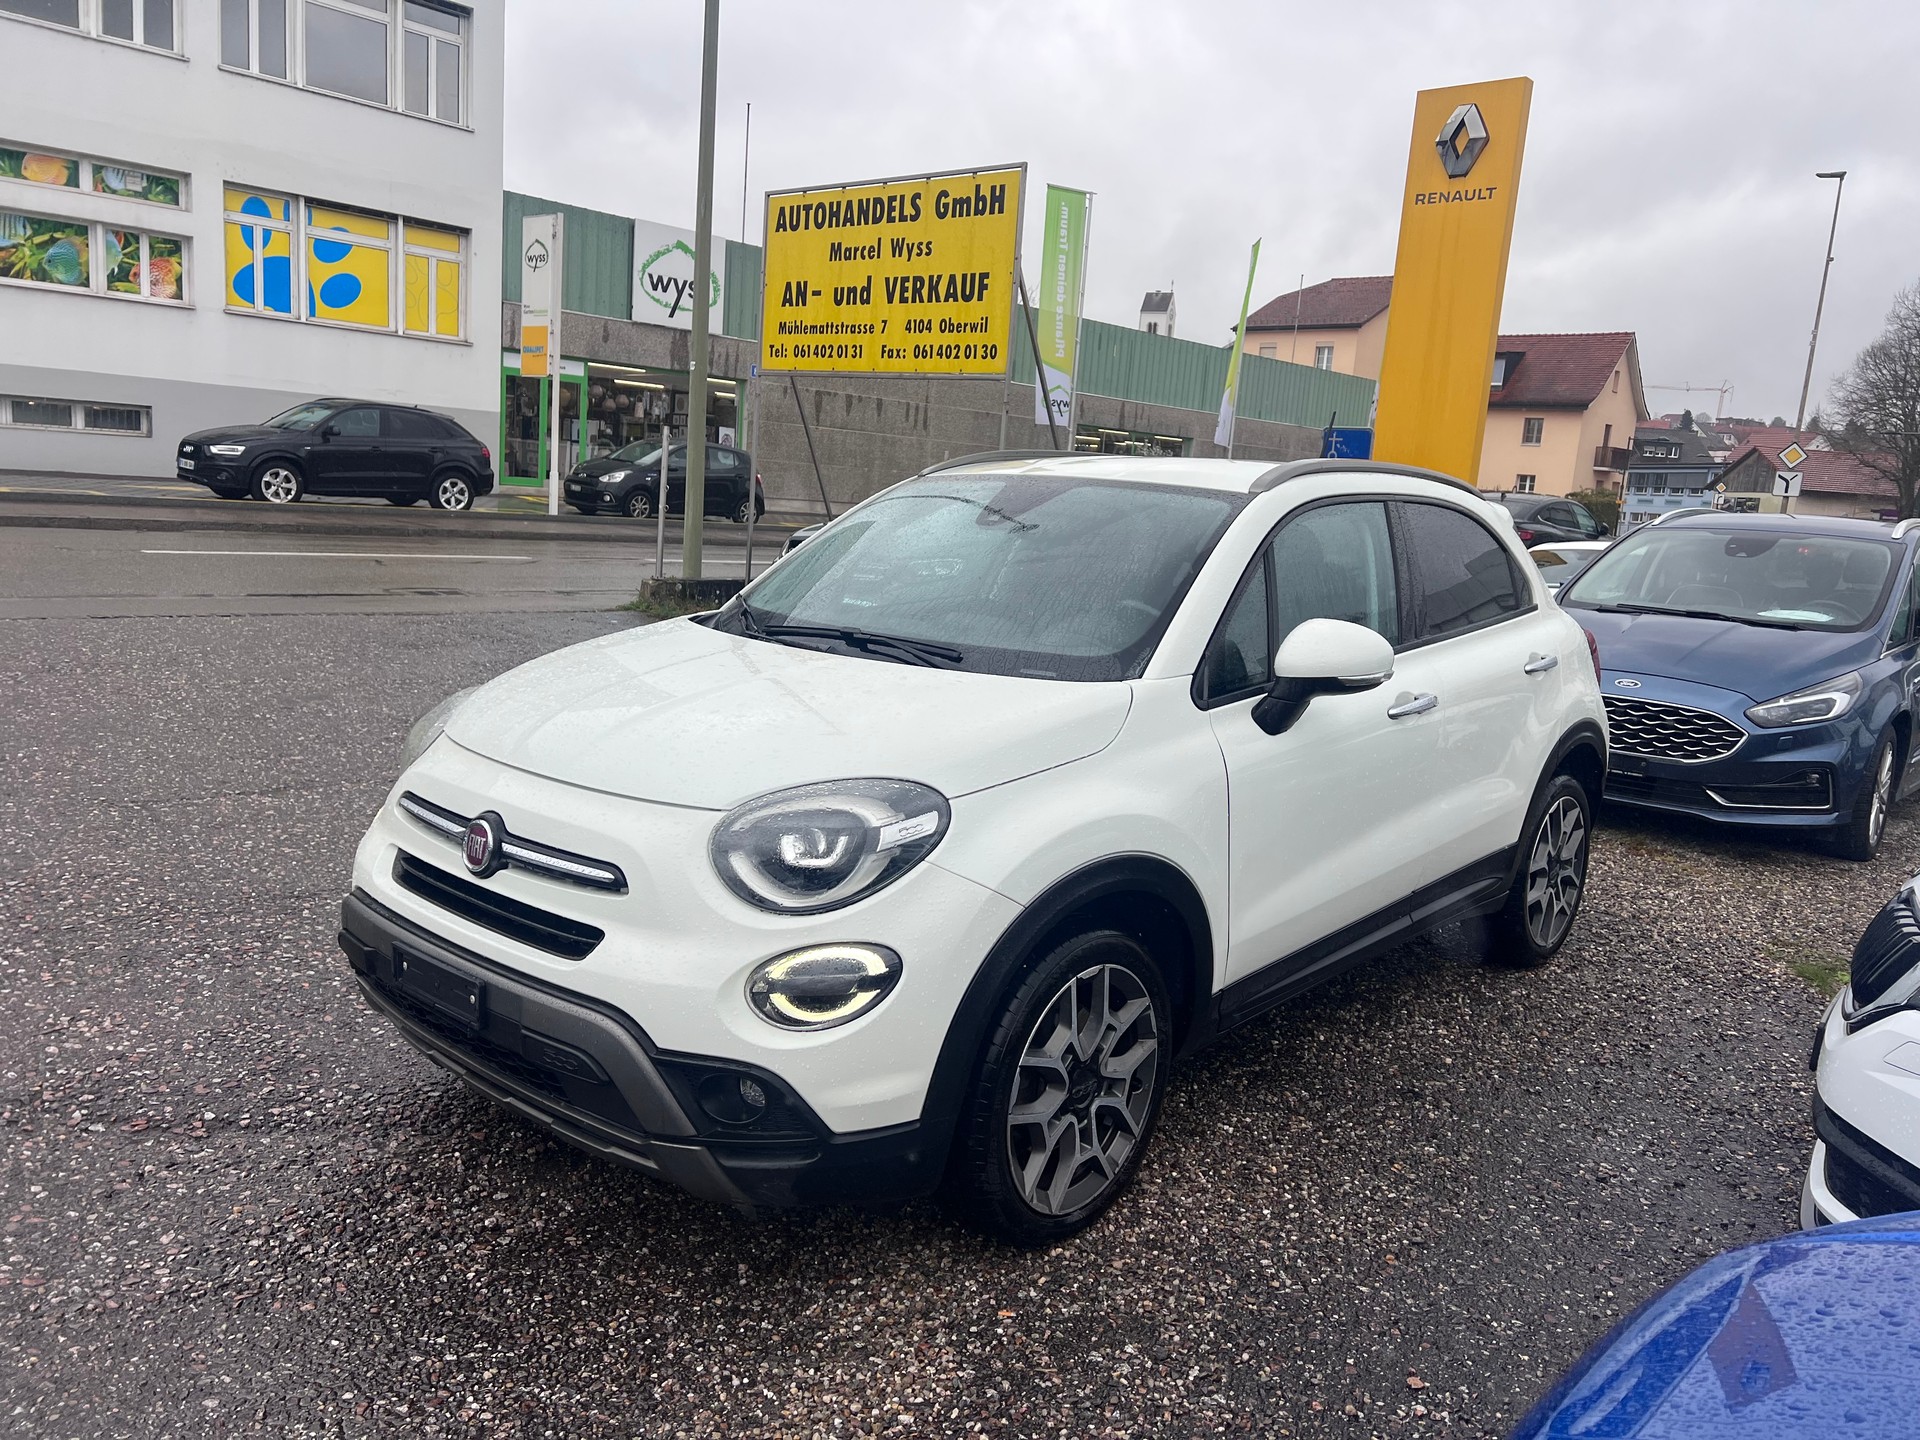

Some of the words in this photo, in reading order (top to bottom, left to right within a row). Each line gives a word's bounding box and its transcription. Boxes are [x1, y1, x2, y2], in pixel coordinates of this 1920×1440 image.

[1414, 187, 1498, 206] RENAULT
[774, 192, 923, 233] AUTOHANDELS
[934, 183, 1006, 221] GmbH
[828, 236, 882, 262] Marcel
[890, 238, 933, 262] Wyss
[527, 253, 546, 272] wyss
[833, 275, 872, 307] und
[884, 271, 990, 305] VERKAUF
[778, 319, 875, 335] Mühlemattstrasse
[880, 319, 888, 334] 7
[904, 318, 933, 334] 4104
[939, 316, 989, 334] Oberwil
[769, 343, 788, 358] Tel:
[880, 344, 907, 360] Fax:
[467, 833, 487, 860] FIAT
